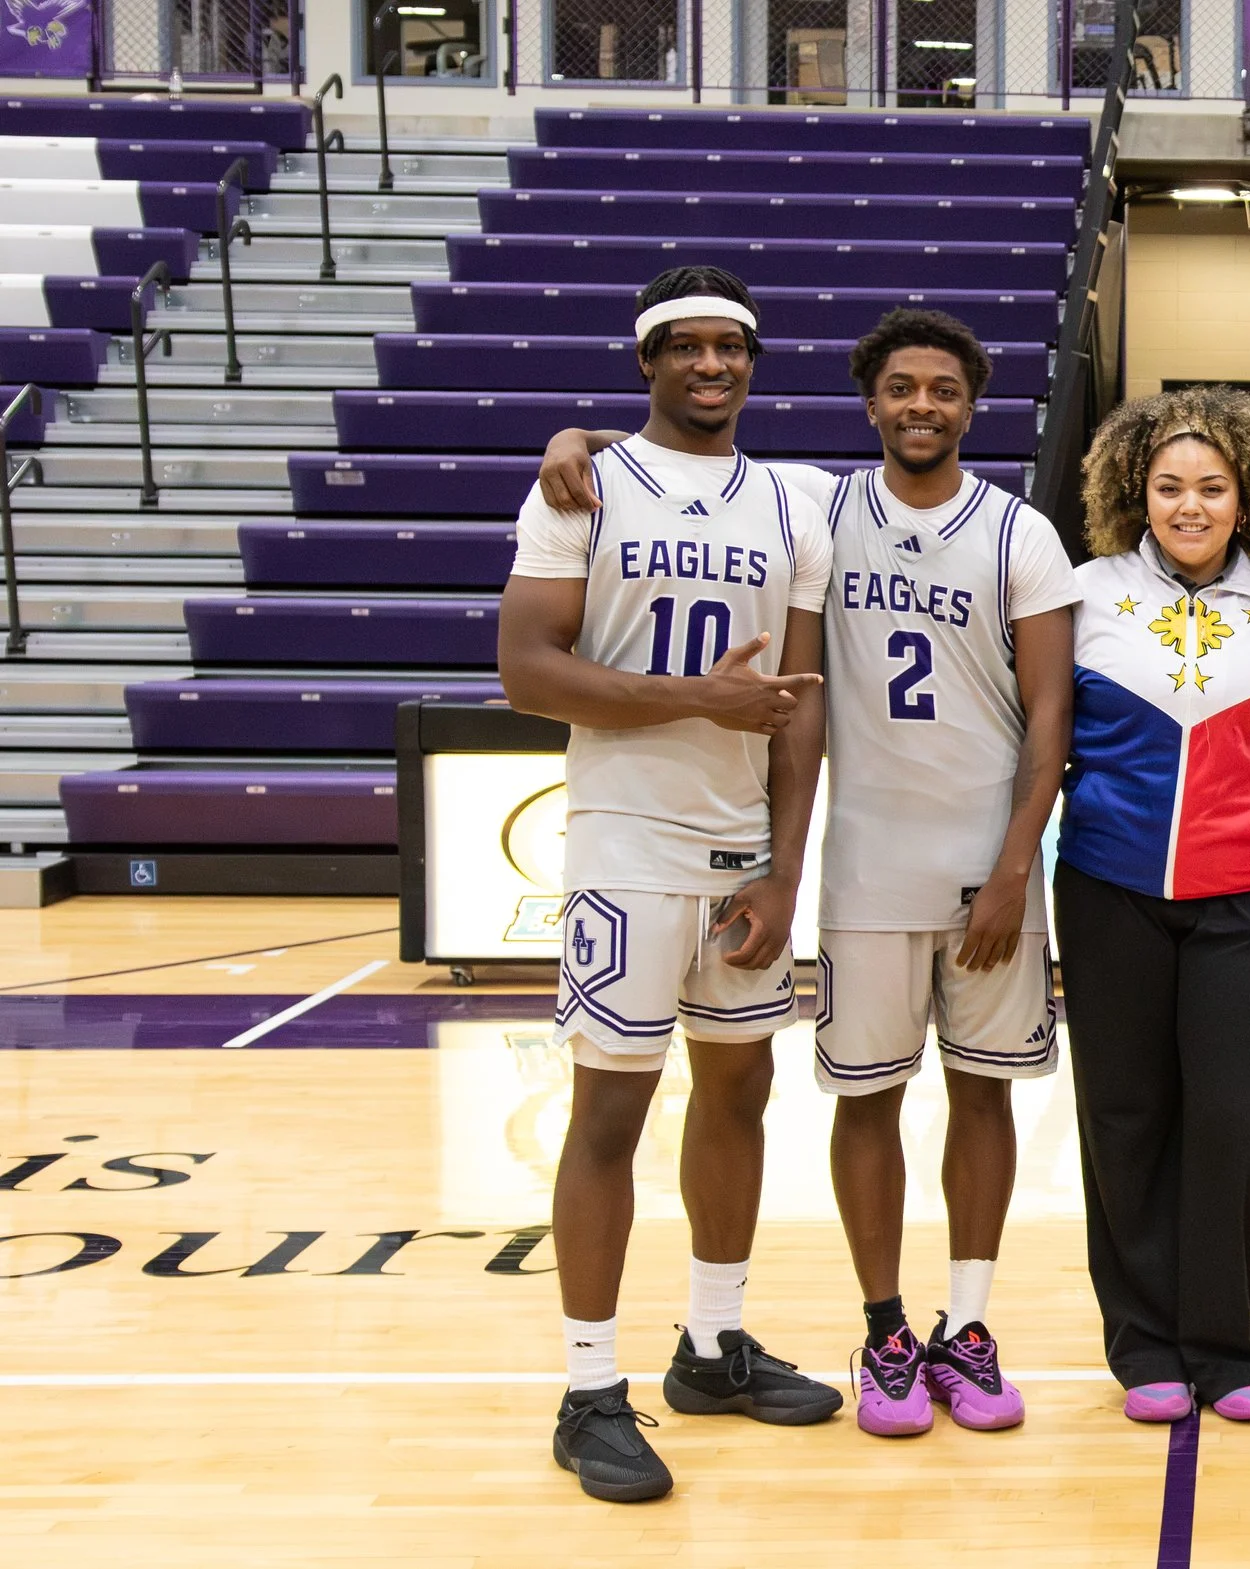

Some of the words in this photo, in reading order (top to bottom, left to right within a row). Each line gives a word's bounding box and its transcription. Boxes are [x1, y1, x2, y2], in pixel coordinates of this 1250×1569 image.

[619, 539, 769, 588] EAGLES
[842, 570, 974, 629] EAGLES
[647, 596, 732, 677] 10
[887, 629, 937, 722] 2
[571, 917, 597, 967] AU
